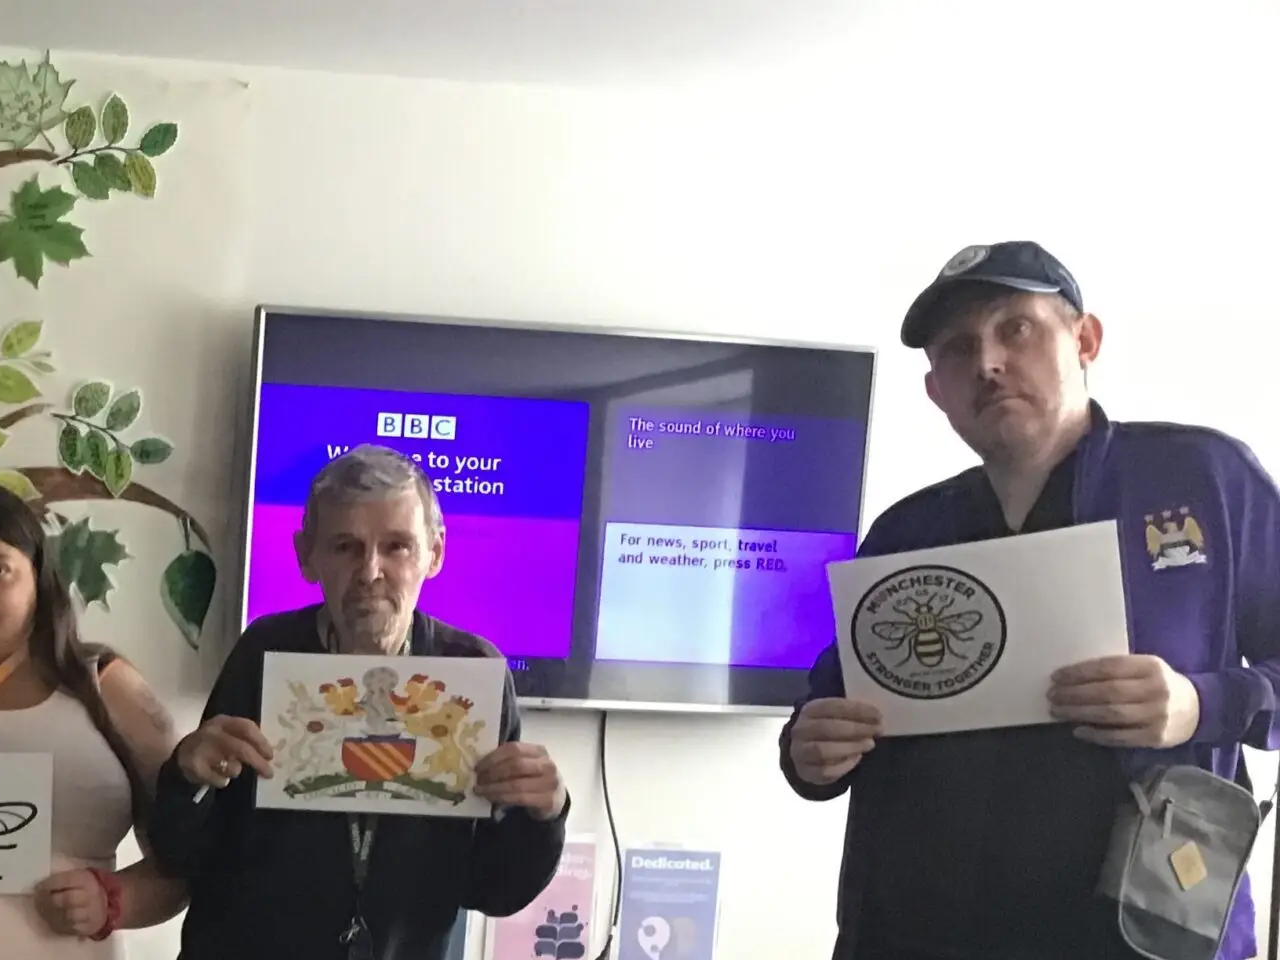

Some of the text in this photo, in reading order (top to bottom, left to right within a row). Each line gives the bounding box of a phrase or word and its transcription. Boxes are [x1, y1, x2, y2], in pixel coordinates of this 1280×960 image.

[381, 414, 453, 438] BBC
[628, 417, 796, 442] The sound of where you
[627, 434, 655, 449] live
[427, 451, 450, 469] to
[454, 455, 502, 474] your
[432, 475, 505, 495] station
[620, 533, 778, 553] For news, sport, travel
[618, 552, 644, 565] and
[649, 554, 708, 569] weather,
[713, 557, 751, 571] press
[866, 641, 994, 691] STRONGER TOGETHER
[631, 855, 715, 872] Dedicated.
